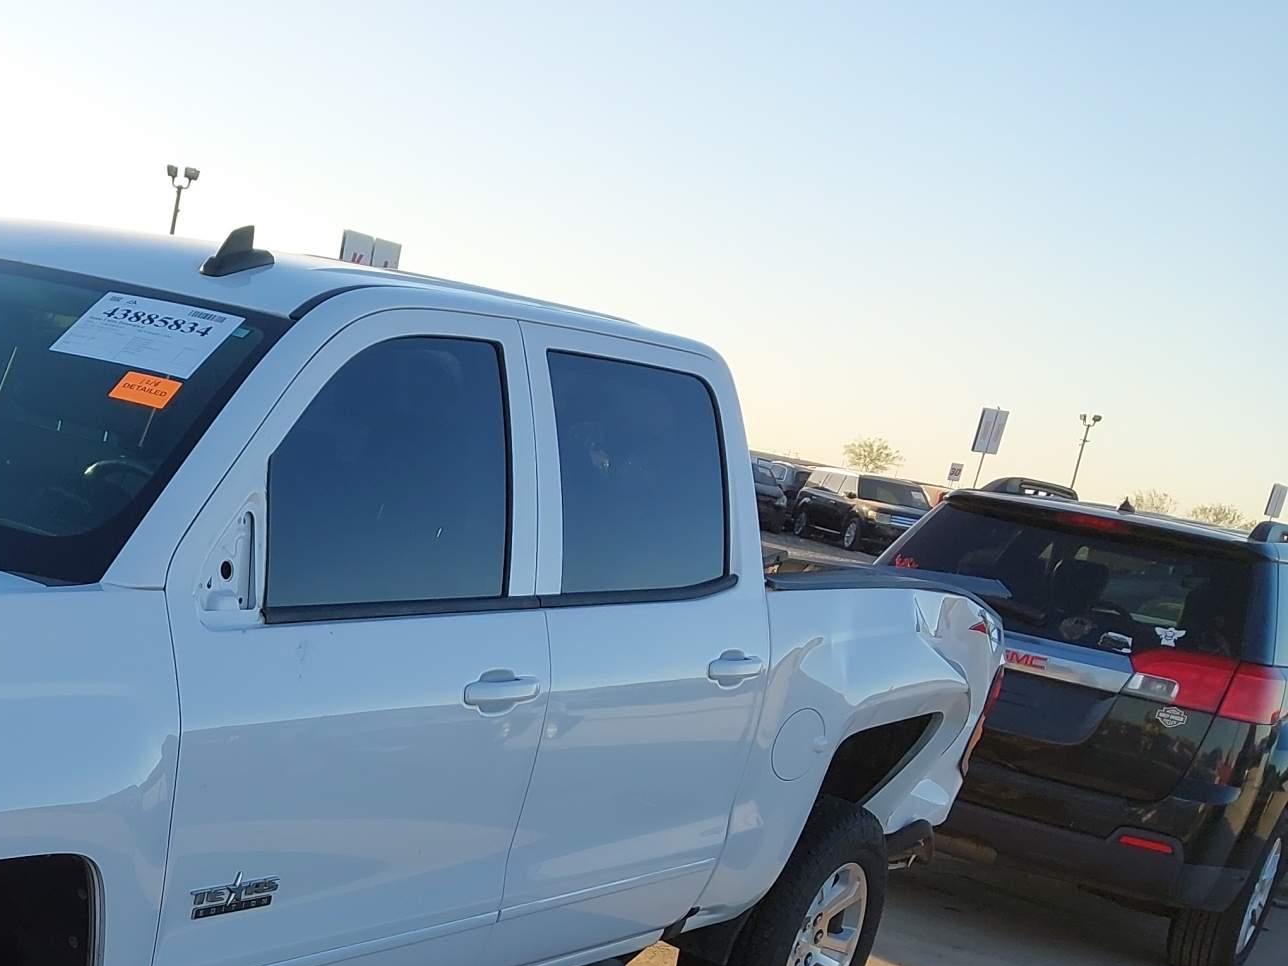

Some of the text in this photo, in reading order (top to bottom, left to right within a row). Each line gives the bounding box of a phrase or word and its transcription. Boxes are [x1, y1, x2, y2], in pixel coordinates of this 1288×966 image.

[103, 307, 213, 337] 43885834
[122, 382, 168, 397] DETAILED
[190, 873, 280, 908] TEXAS
